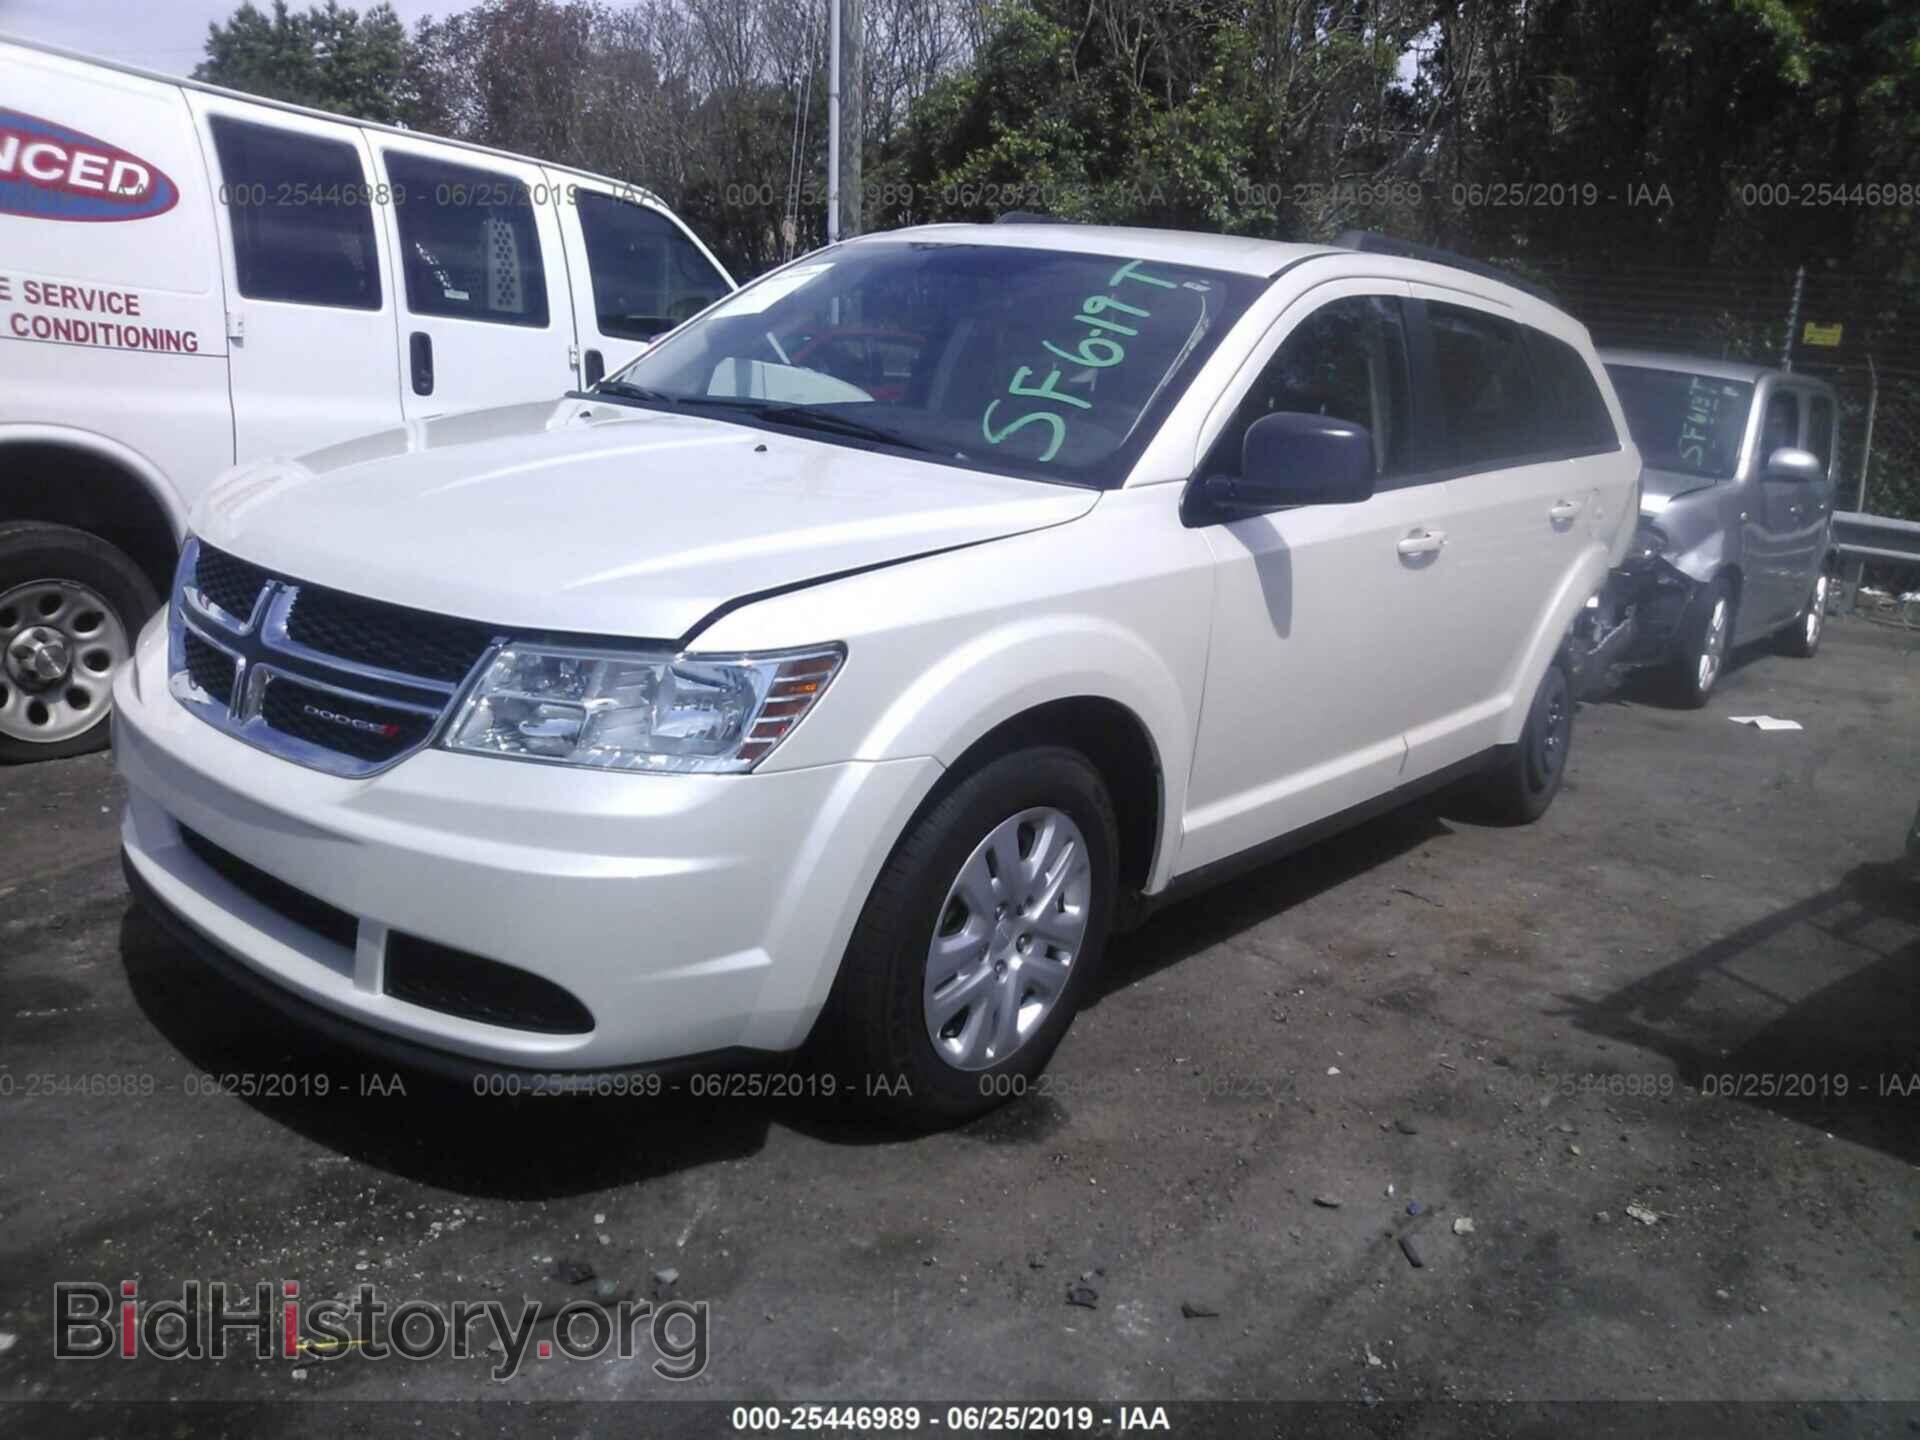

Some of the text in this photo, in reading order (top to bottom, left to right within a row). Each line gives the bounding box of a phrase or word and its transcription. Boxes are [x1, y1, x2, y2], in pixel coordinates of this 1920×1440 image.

[23, 280, 141, 316] SERVICE
[10, 313, 198, 352] CONDITIONING
[303, 704, 386, 735] DODGE
